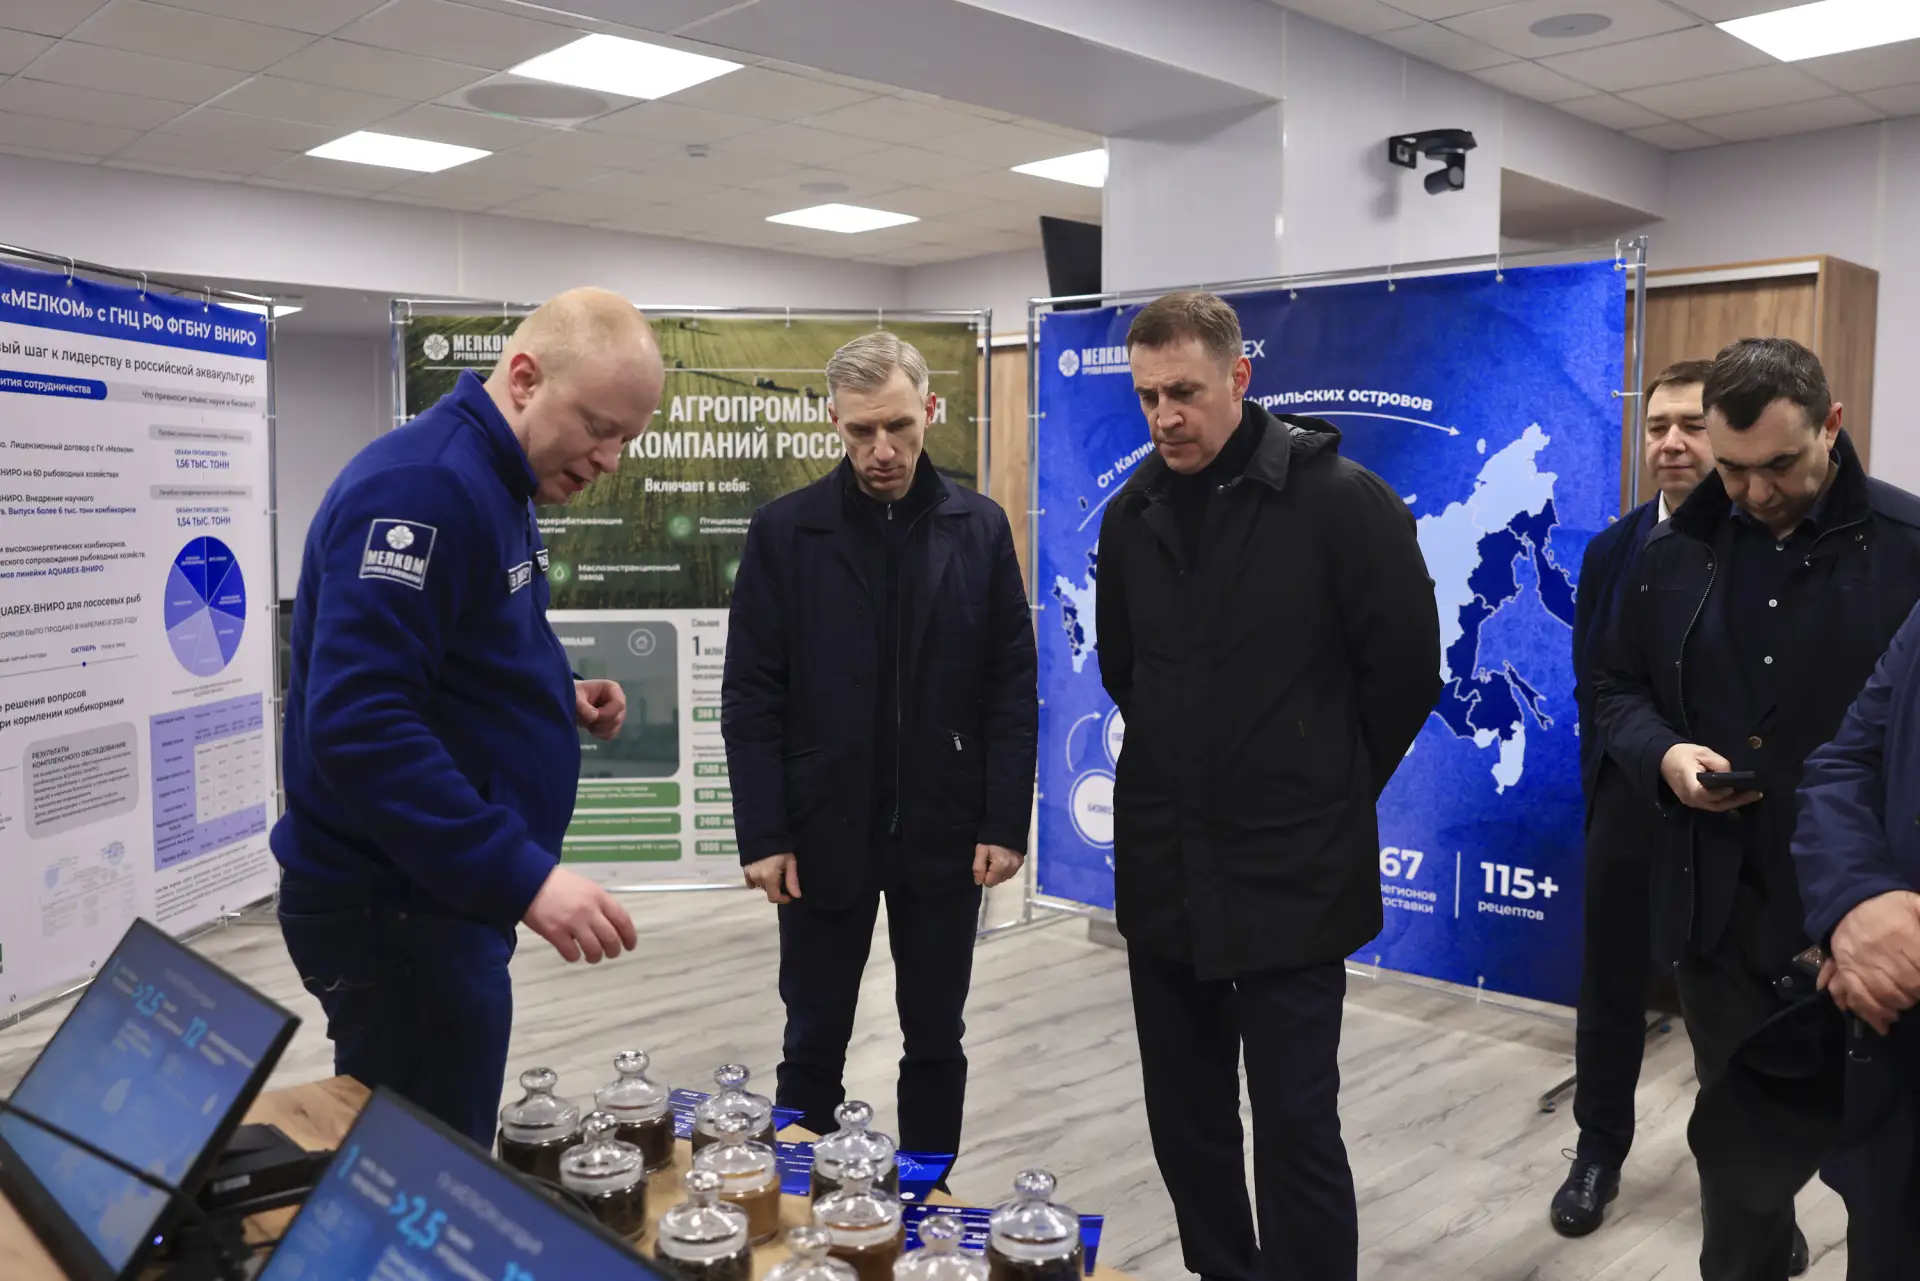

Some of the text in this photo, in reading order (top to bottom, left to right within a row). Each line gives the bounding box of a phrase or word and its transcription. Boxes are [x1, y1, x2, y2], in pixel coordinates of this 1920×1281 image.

[1, 288, 257, 347] «МЕЛКОМ» с ГНЦ РФ ФГБНУ ВНИРО
[24, 345, 49, 359] шаг
[52, 350, 59, 360] к
[61, 350, 122, 370] лидерству
[125, 359, 132, 368] в
[134, 359, 194, 377] российской
[195, 368, 255, 386] аквакультуре
[0, 377, 91, 394] ития сотрудничества
[142, 391, 154, 400] Что
[1348, 388, 1433, 412] островов
[10, 440, 63, 451] Лицензионный
[64, 443, 91, 453] договор
[97, 444, 104, 452] ГК
[629, 426, 769, 460] КОМПАНИЙ
[191, 459, 209, 469] ТЫС.
[210, 460, 230, 470] ТОНН
[0, 468, 22, 477] НИРО
[33, 469, 42, 477] 60
[43, 468, 84, 479] рыбоводных
[85, 469, 119, 478] хозяйствах
[1097, 469, 1115, 488] От
[644, 477, 751, 493] Включает в себя:
[25, 494, 64, 504] Внедрение
[64, 495, 94, 504] научного
[8, 507, 36, 517] Выпуск
[36, 506, 58, 515] более
[95, 505, 137, 515] комбикормов
[192, 517, 210, 526] ТЫС.
[211, 516, 231, 526] ТОНН
[5, 542, 83, 554] высокоэнергетических
[0, 557, 24, 567] еского
[25, 554, 79, 566] сопровождения
[79, 552, 119, 563] рыбоводных
[366, 549, 425, 574] МЕЛКОМ
[16, 567, 47, 579] линейки
[0, 593, 142, 618] UAREX-ВНИРО для лососевых рыб
[45, 624, 75, 635] ПРОДАНО
[71, 644, 97, 654] ОКТЯБРЬ
[692, 635, 700, 657] 1
[4, 689, 87, 713] решения вопросов
[13, 708, 63, 727] кормлении
[64, 697, 125, 717] комбикормами
[31, 745, 70, 760] РЕЗУЛЬТАТЫ
[32, 741, 126, 769] КОМПЛЕКСНОГО ОБСЛЕДОВАНИЯ
[1380, 846, 1559, 900] 67 115+
[1381, 896, 1545, 921] оставки рецептов
